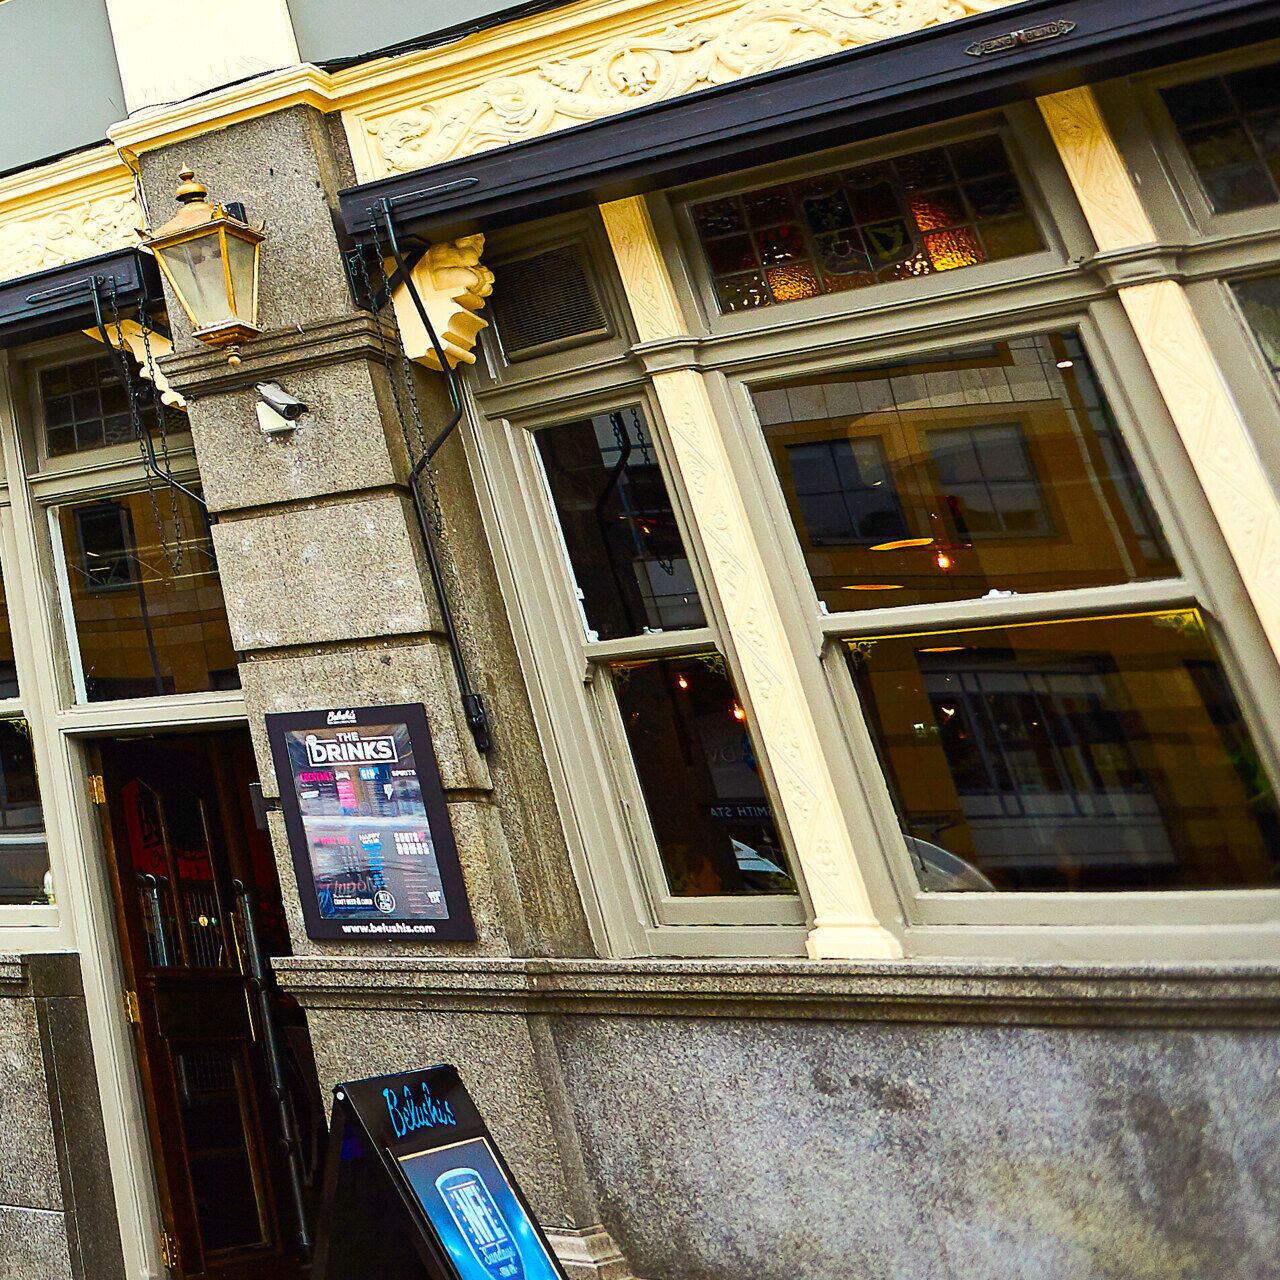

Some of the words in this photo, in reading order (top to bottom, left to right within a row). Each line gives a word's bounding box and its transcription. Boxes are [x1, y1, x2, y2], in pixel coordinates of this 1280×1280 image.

[336, 732, 360, 742] THE
[312, 741, 394, 763] DRINKS
[342, 923, 436, 934] www.belushis.com
